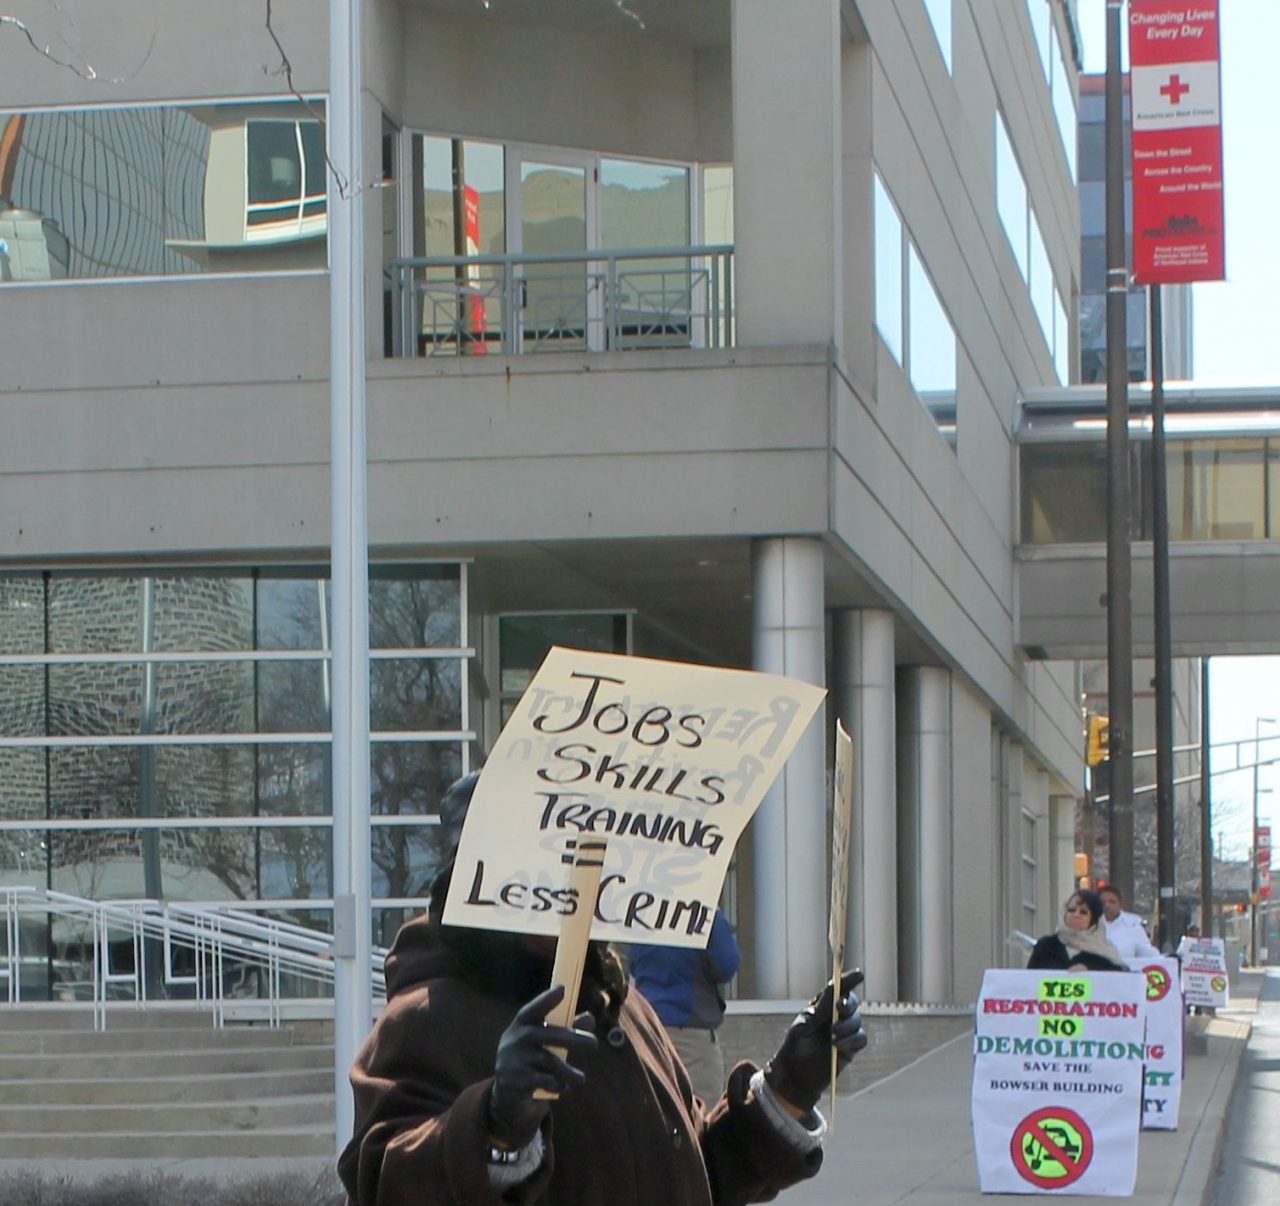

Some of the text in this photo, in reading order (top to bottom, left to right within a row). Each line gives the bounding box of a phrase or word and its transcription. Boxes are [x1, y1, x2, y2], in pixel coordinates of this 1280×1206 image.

[1130, 9, 1216, 25] Changing Lives
[1147, 24, 1204, 40] Every Day
[537, 744, 726, 806] SKILLS
[534, 791, 724, 857] TRAINING
[1042, 981, 1085, 997] YES
[982, 998, 1138, 1018] RESTORATION
[1041, 1018, 1077, 1036] NO
[976, 1036, 1146, 1060] DEMOLITION
[1023, 1061, 1092, 1073] SAVE THE
[990, 1080, 1124, 1094] BOWSER BUILDING
